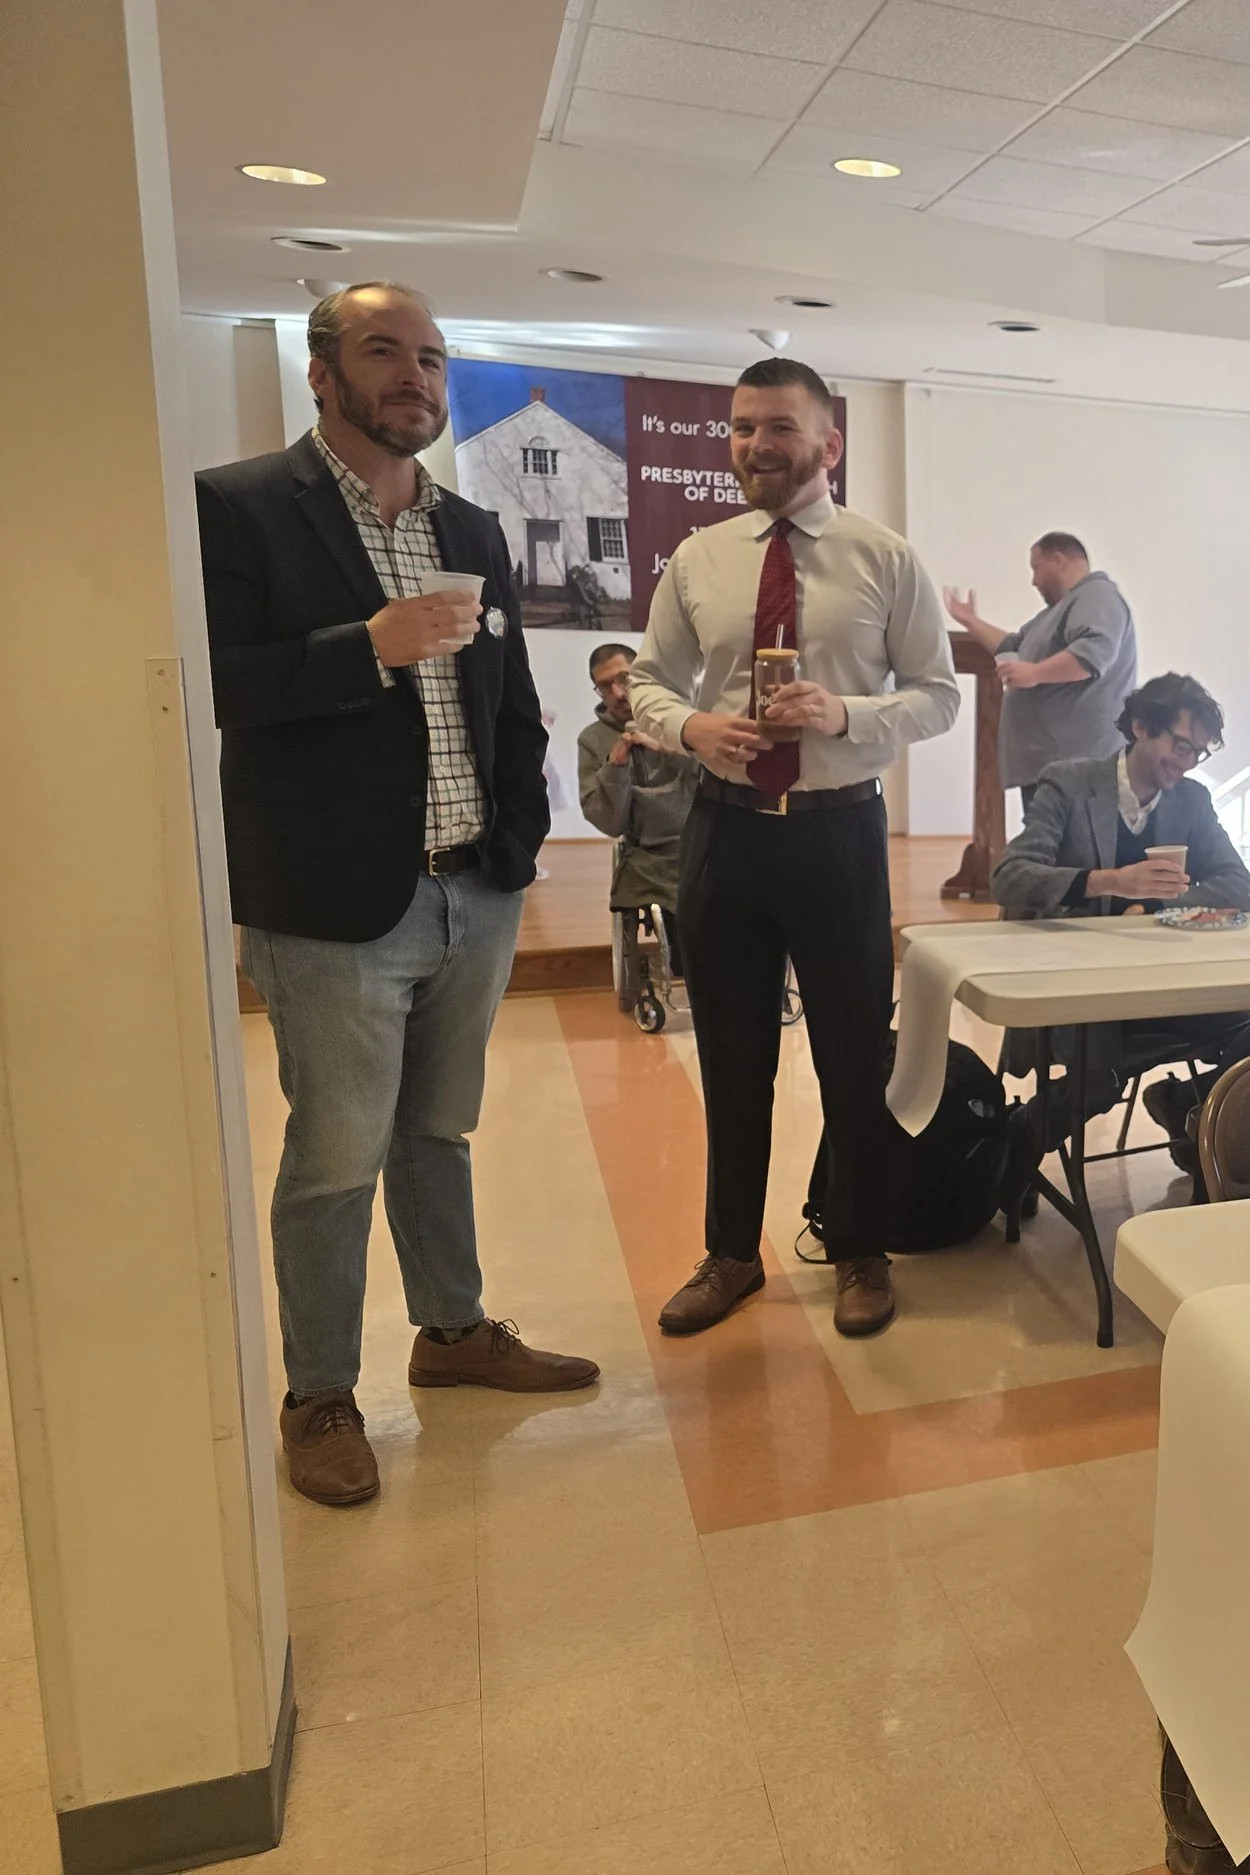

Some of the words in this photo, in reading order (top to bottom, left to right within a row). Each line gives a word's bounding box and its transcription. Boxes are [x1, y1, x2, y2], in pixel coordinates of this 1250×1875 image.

[642, 414, 665, 433] It's
[670, 422, 700, 436] our
[684, 485, 709, 501] OF
